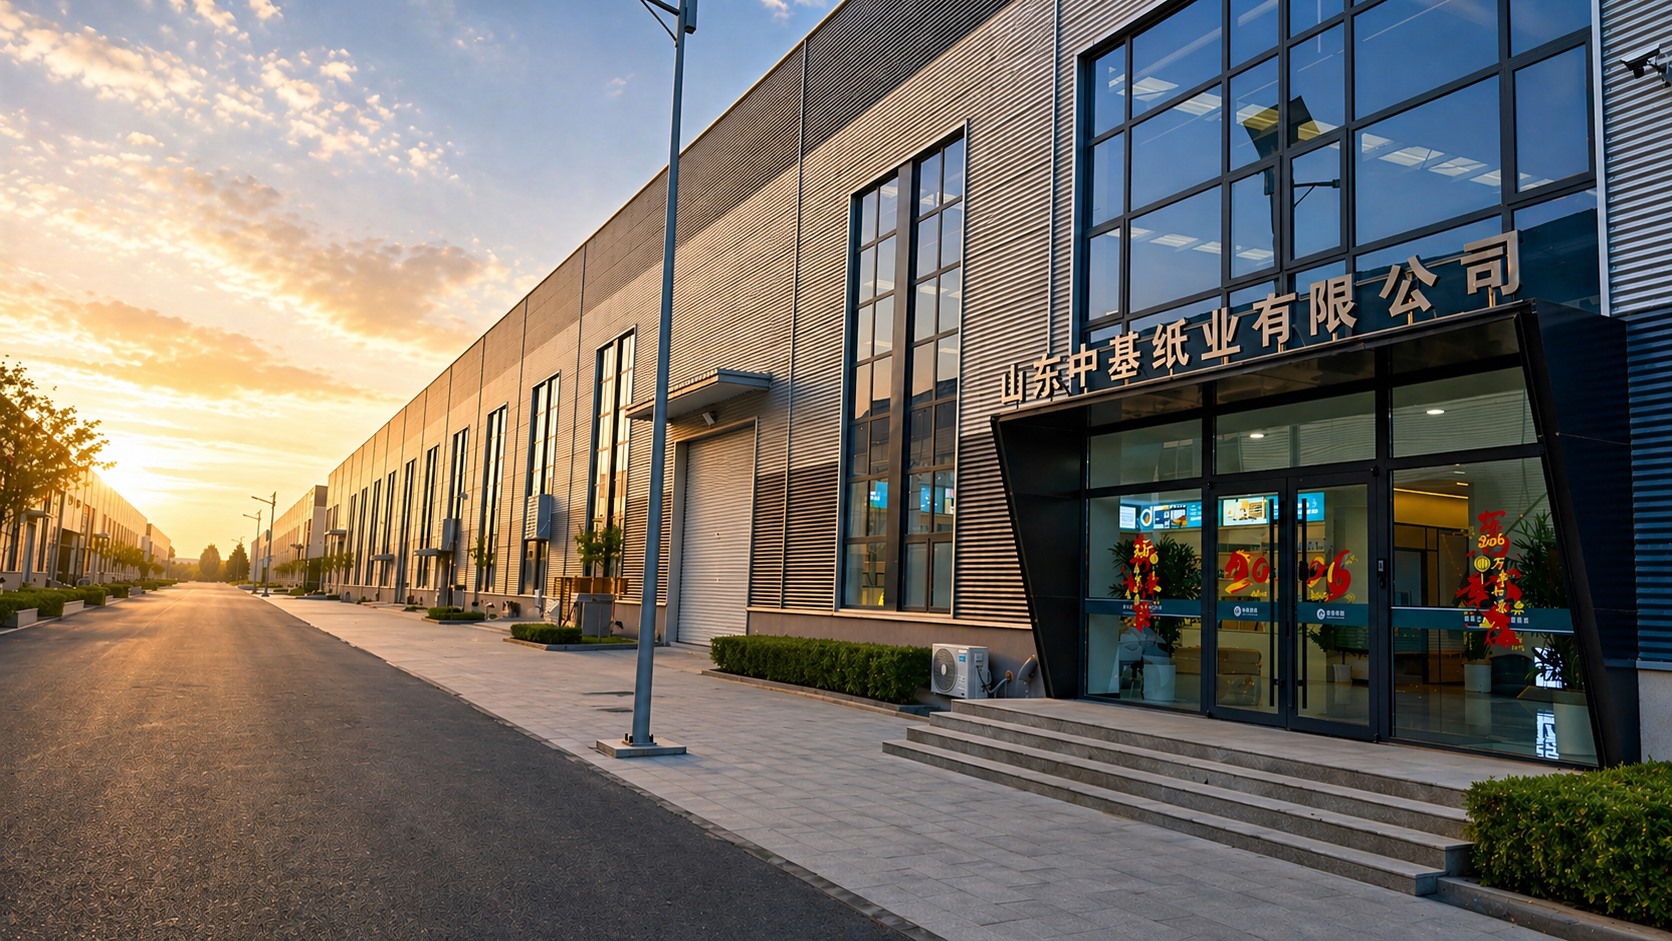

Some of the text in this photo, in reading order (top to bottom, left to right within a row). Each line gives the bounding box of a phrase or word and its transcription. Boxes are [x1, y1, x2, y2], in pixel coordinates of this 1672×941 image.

[1001, 230, 1522, 404] 山东中基纸业有限公司
